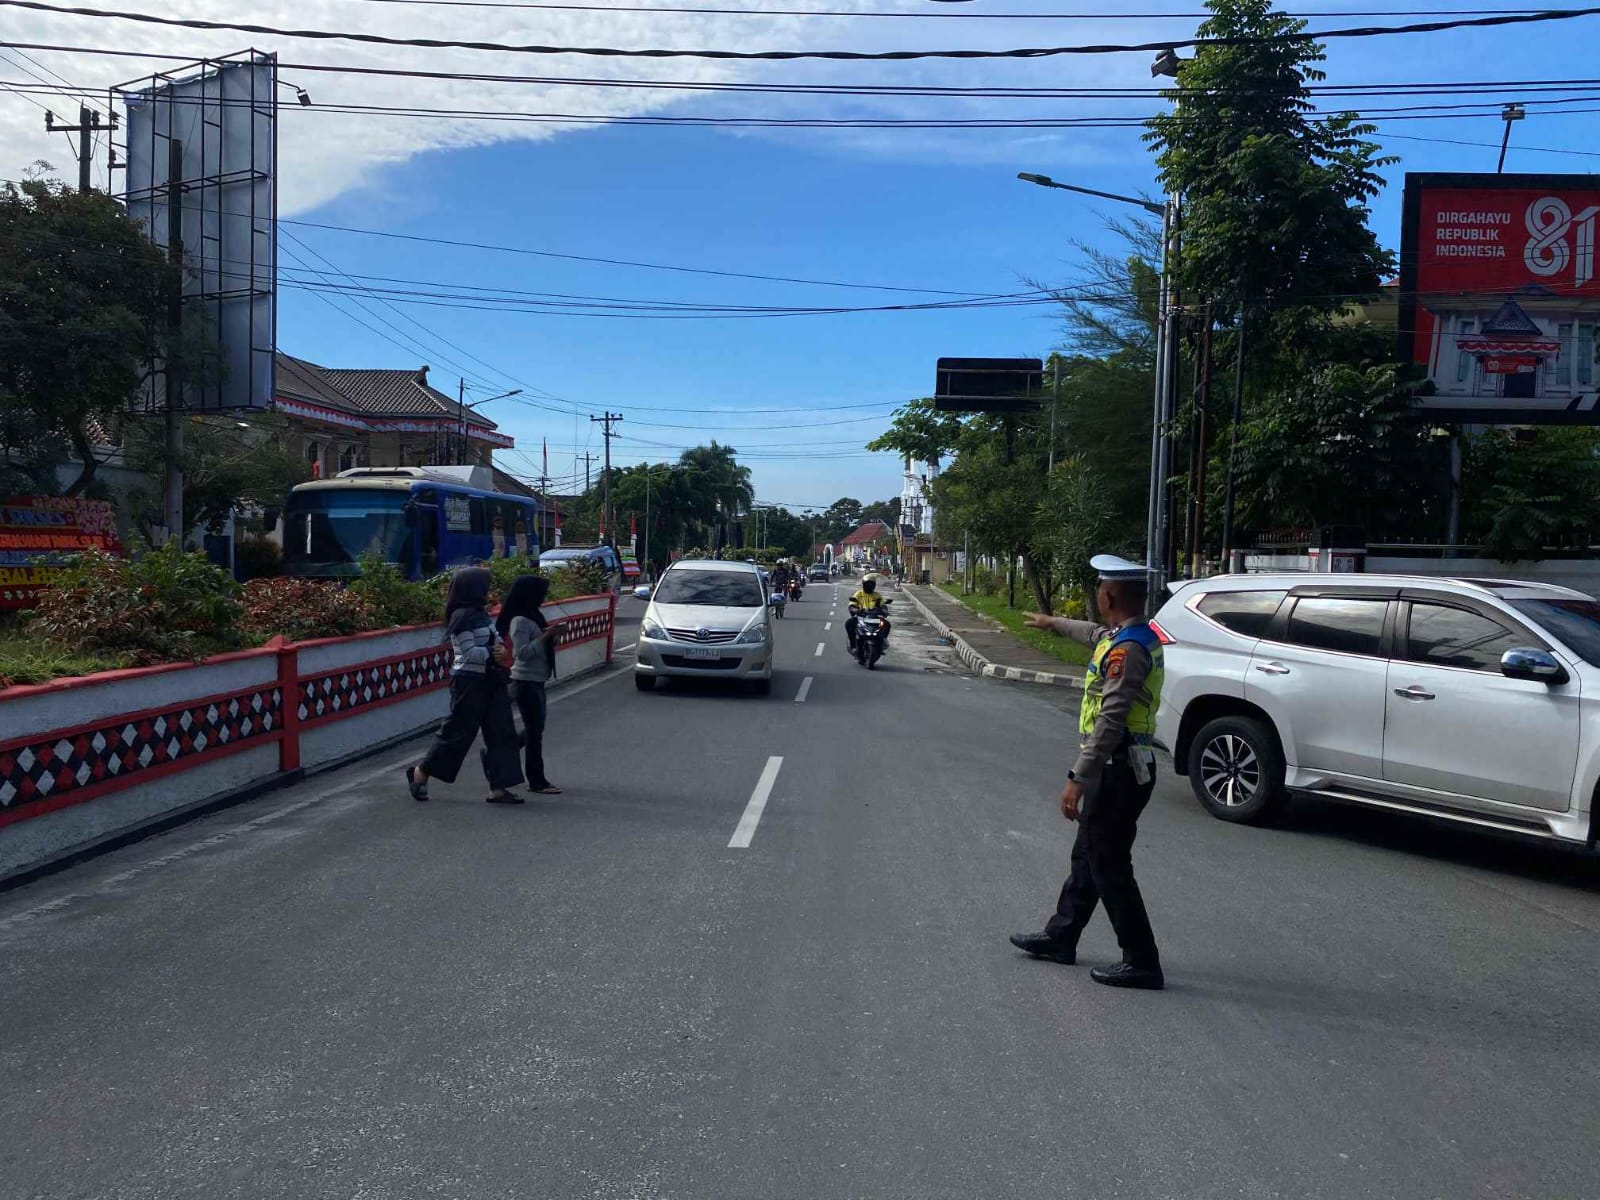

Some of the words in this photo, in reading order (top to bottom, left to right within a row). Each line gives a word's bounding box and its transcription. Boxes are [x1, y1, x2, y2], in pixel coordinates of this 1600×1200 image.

[1436, 211, 1511, 225] DIRGAHAYU
[1436, 228, 1499, 241] REPUBLIK
[1523, 196, 1600, 288] 81
[1436, 244, 1506, 257] INDONESIA
